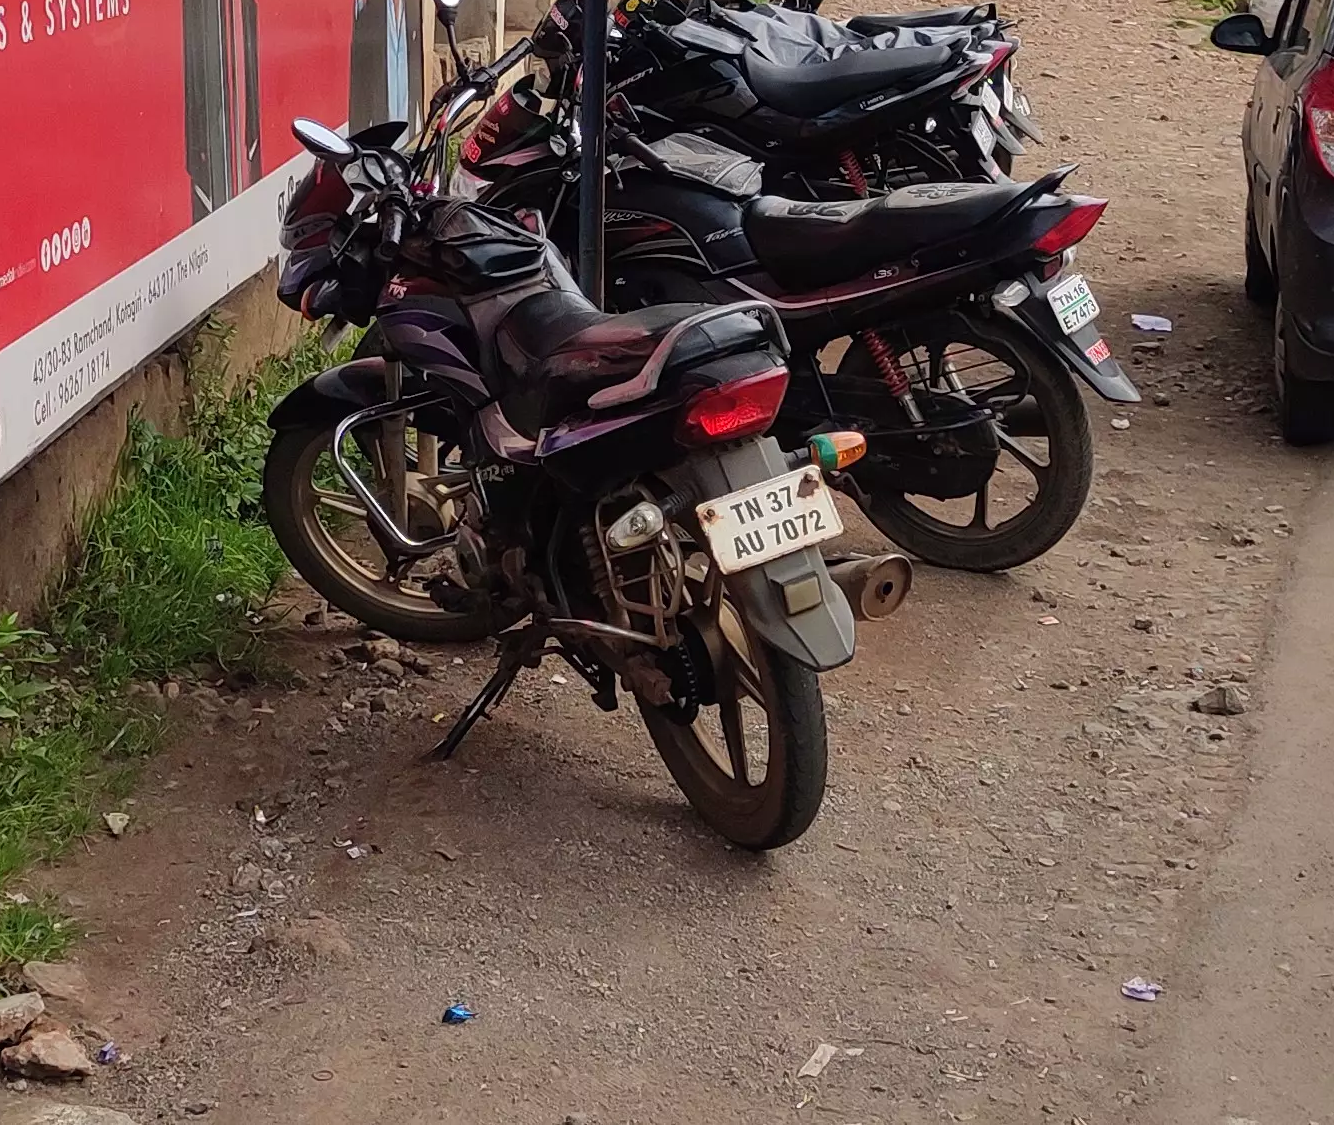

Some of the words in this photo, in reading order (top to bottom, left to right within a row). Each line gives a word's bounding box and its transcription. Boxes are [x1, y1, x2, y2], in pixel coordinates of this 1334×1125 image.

[21, 1, 33, 43] &
[115, 288, 143, 327] Kotagiri
[148, 277, 161, 305] 643
[177, 259, 188, 282] The
[34, 390, 52, 427] Cell
[58, 369, 83, 408] 96267
[86, 348, 111, 386] 18174
[730, 497, 765, 525] TN
[766, 485, 794, 513] 37
[733, 529, 765, 559] AU
[767, 509, 826, 546] 7072
